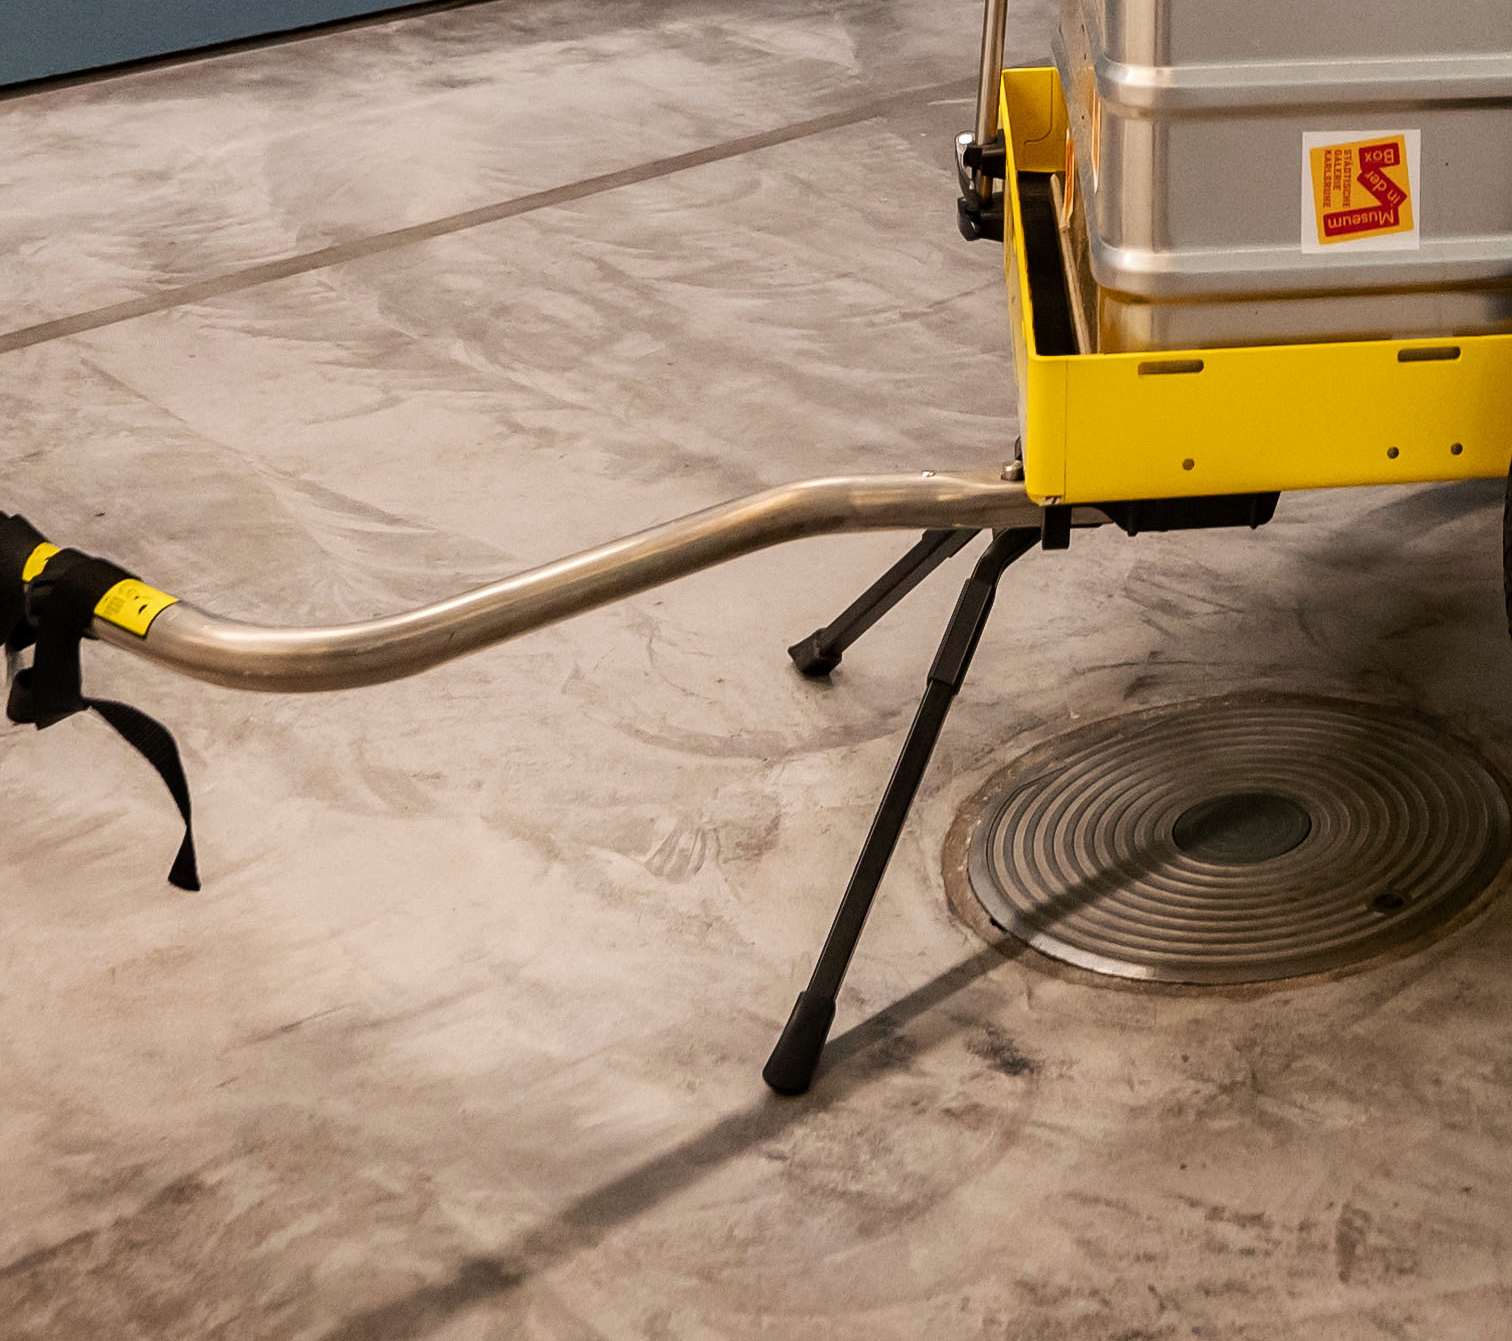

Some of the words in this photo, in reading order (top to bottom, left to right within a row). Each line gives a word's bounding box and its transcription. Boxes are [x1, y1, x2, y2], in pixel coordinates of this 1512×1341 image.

[1364, 148, 1394, 164] Box
[1365, 171, 1388, 192] der
[1386, 189, 1401, 207] in
[1327, 208, 1395, 229] Museum
